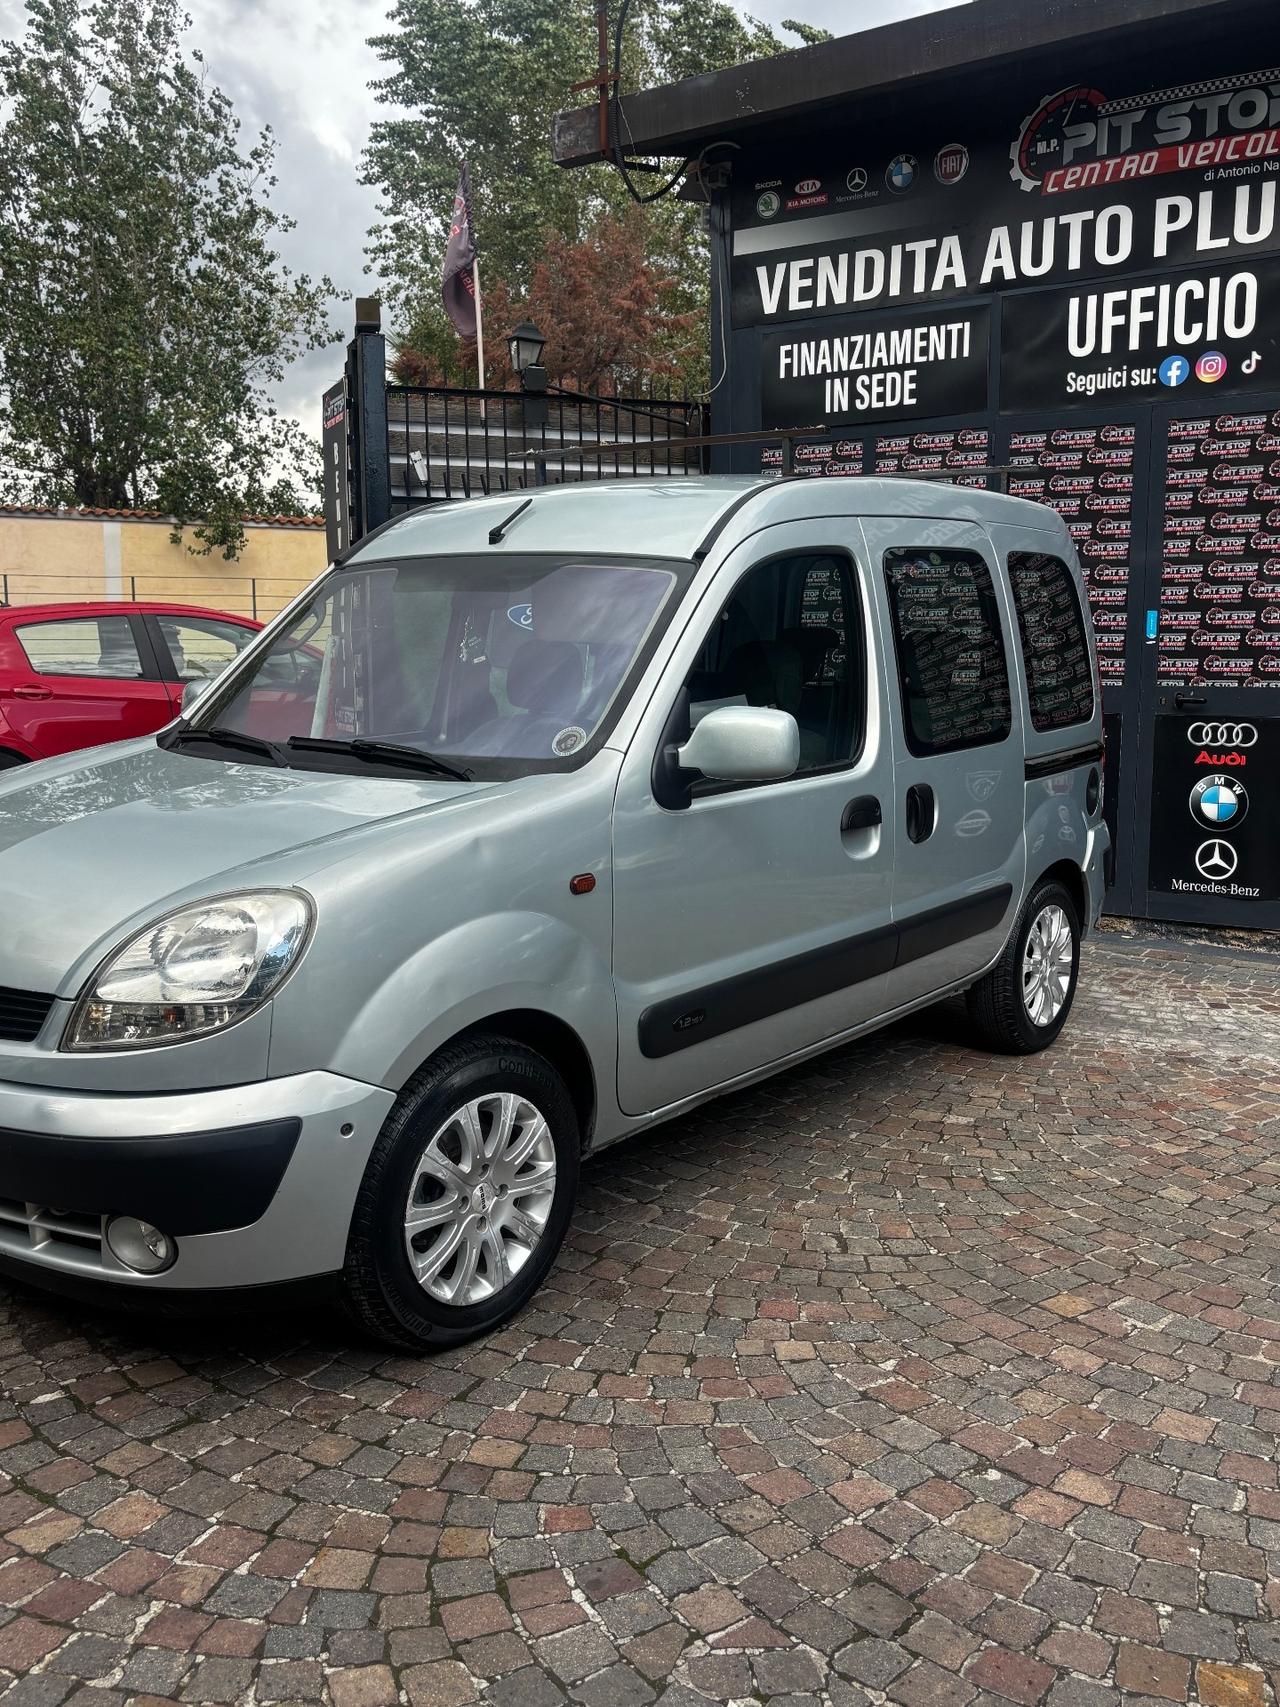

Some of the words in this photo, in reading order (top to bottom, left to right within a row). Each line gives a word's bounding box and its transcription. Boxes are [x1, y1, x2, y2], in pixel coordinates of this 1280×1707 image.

[1062, 109, 1147, 166] PIT
[941, 155, 962, 175] FIAT
[1204, 170, 1214, 182] di
[1217, 164, 1261, 180] Antonio
[798, 181, 817, 193] KIA
[800, 195, 827, 206] MOTORS
[835, 190, 880, 203] Mercedes-Benz
[757, 236, 967, 315] VENDITA
[979, 204, 1134, 284] AUTO
[1153, 181, 1277, 258] PLU
[1067, 272, 1258, 358] UFFICIO
[779, 321, 971, 379] FINANZIAMENTI
[1066, 371, 1127, 396] Seguici
[1130, 366, 1157, 387] su:
[825, 378, 851, 414] IN
[855, 370, 917, 409] SEDE
[1170, 424, 1185, 432] PIT
[1242, 417, 1267, 425] STOP
[1171, 445, 1195, 454] STOP
[1226, 441, 1251, 449] STOP
[1239, 467, 1264, 475] STOP
[1224, 490, 1248, 498] STOP
[1194, 750, 1247, 766] Audi
[1196, 776, 1243, 795] BMW
[1171, 878, 1260, 897] Mercedes-Benz
